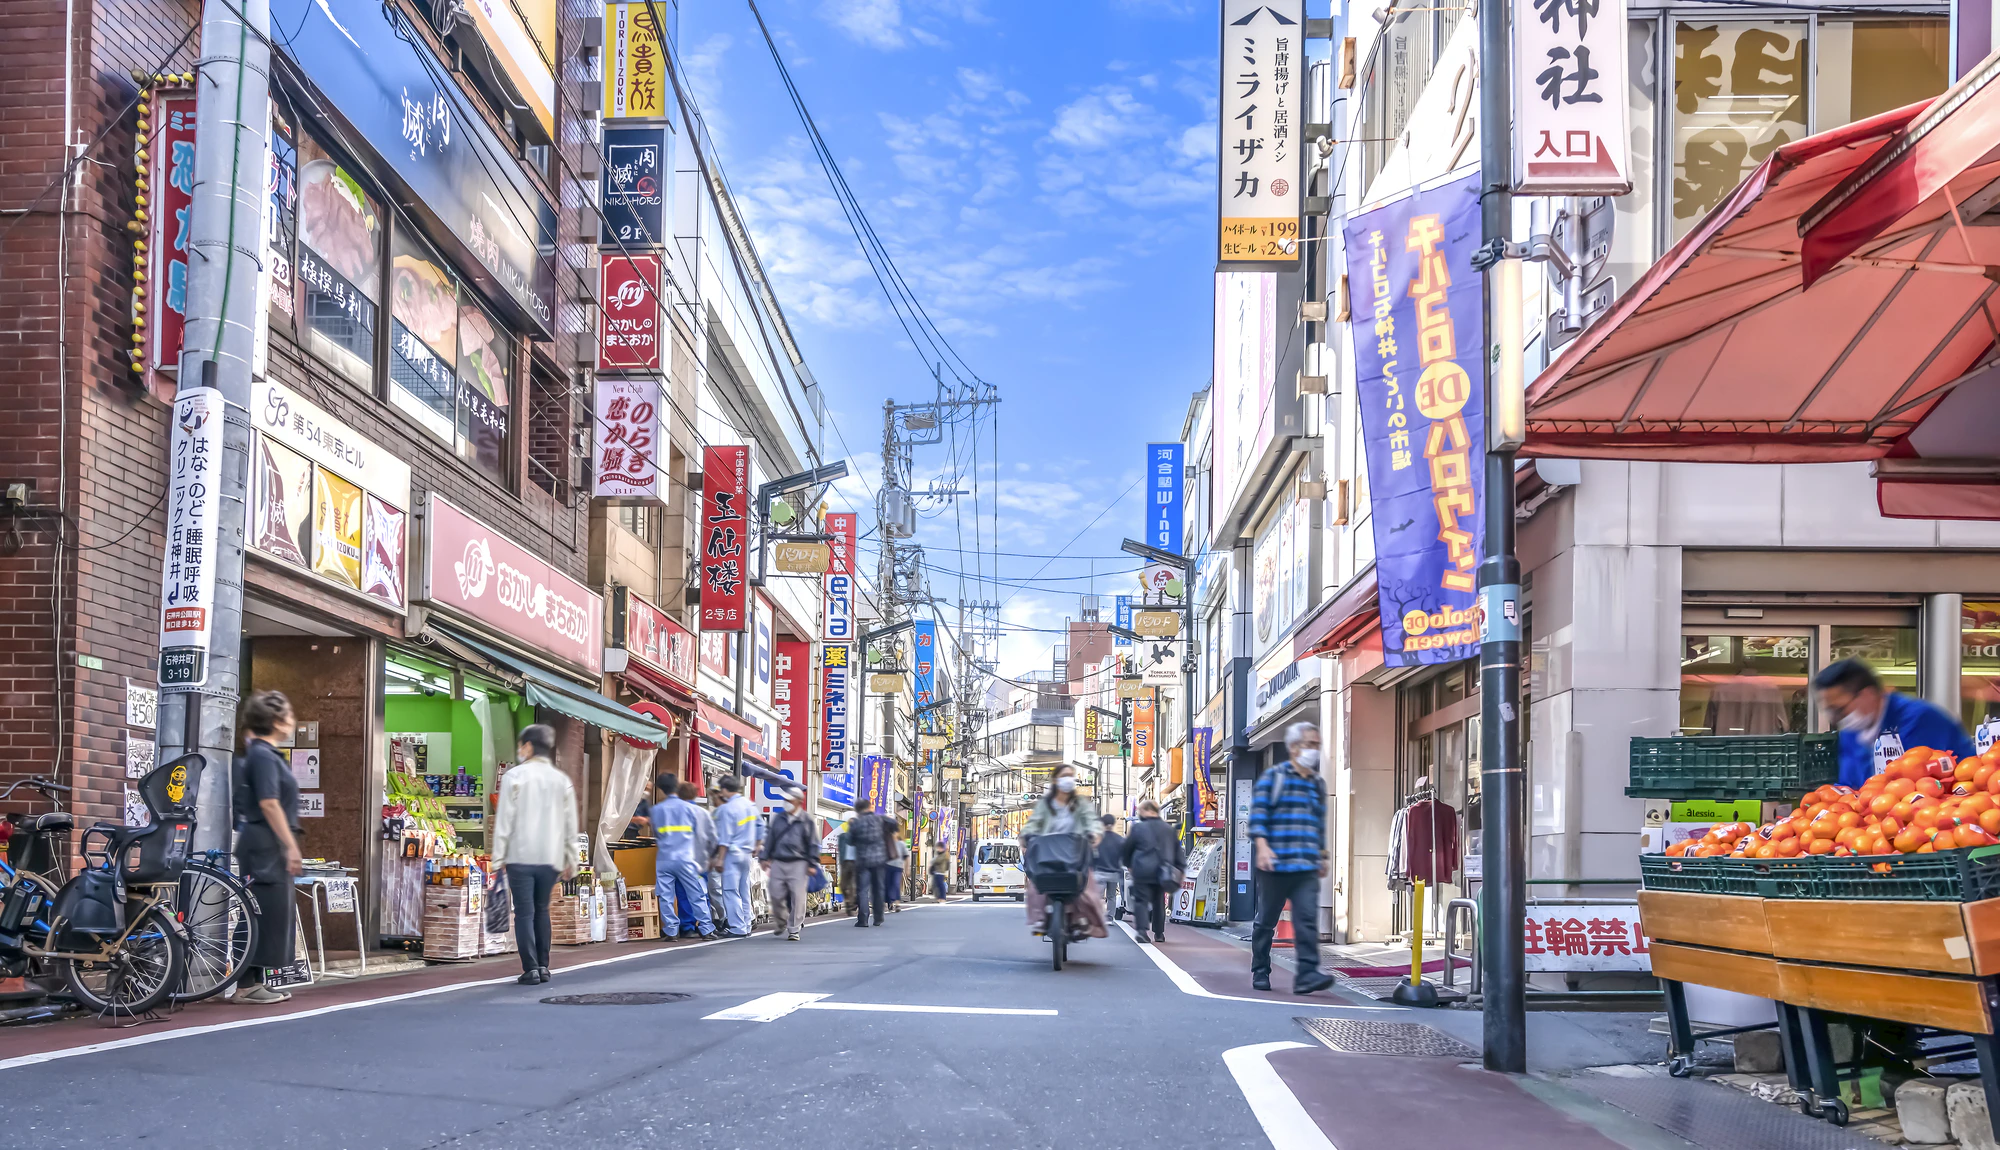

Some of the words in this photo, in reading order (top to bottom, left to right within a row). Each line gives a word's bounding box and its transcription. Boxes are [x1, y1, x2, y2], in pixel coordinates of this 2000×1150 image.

[1273, 37, 1289, 163] 旨唐揚げと居酒メシ
[1233, 37, 1264, 199] ミライザカ
[1534, 129, 1591, 158] 入口
[1224, 223, 1258, 237] ハイボール
[1223, 241, 1257, 256] 生ビール
[608, 317, 653, 332] おかしの
[606, 333, 654, 347] まちおか
[612, 383, 625, 394] New
[292, 411, 365, 469] 第54東京ビル
[169, 439, 188, 580] クリニック石神井
[497, 562, 589, 645] おかしまちおか
[705, 608, 738, 620] 2号店
[165, 653, 196, 666] 石神井町
[824, 646, 847, 668] 薬
[167, 667, 190, 680] 3-19
[1686, 808, 1715, 818] alessia
